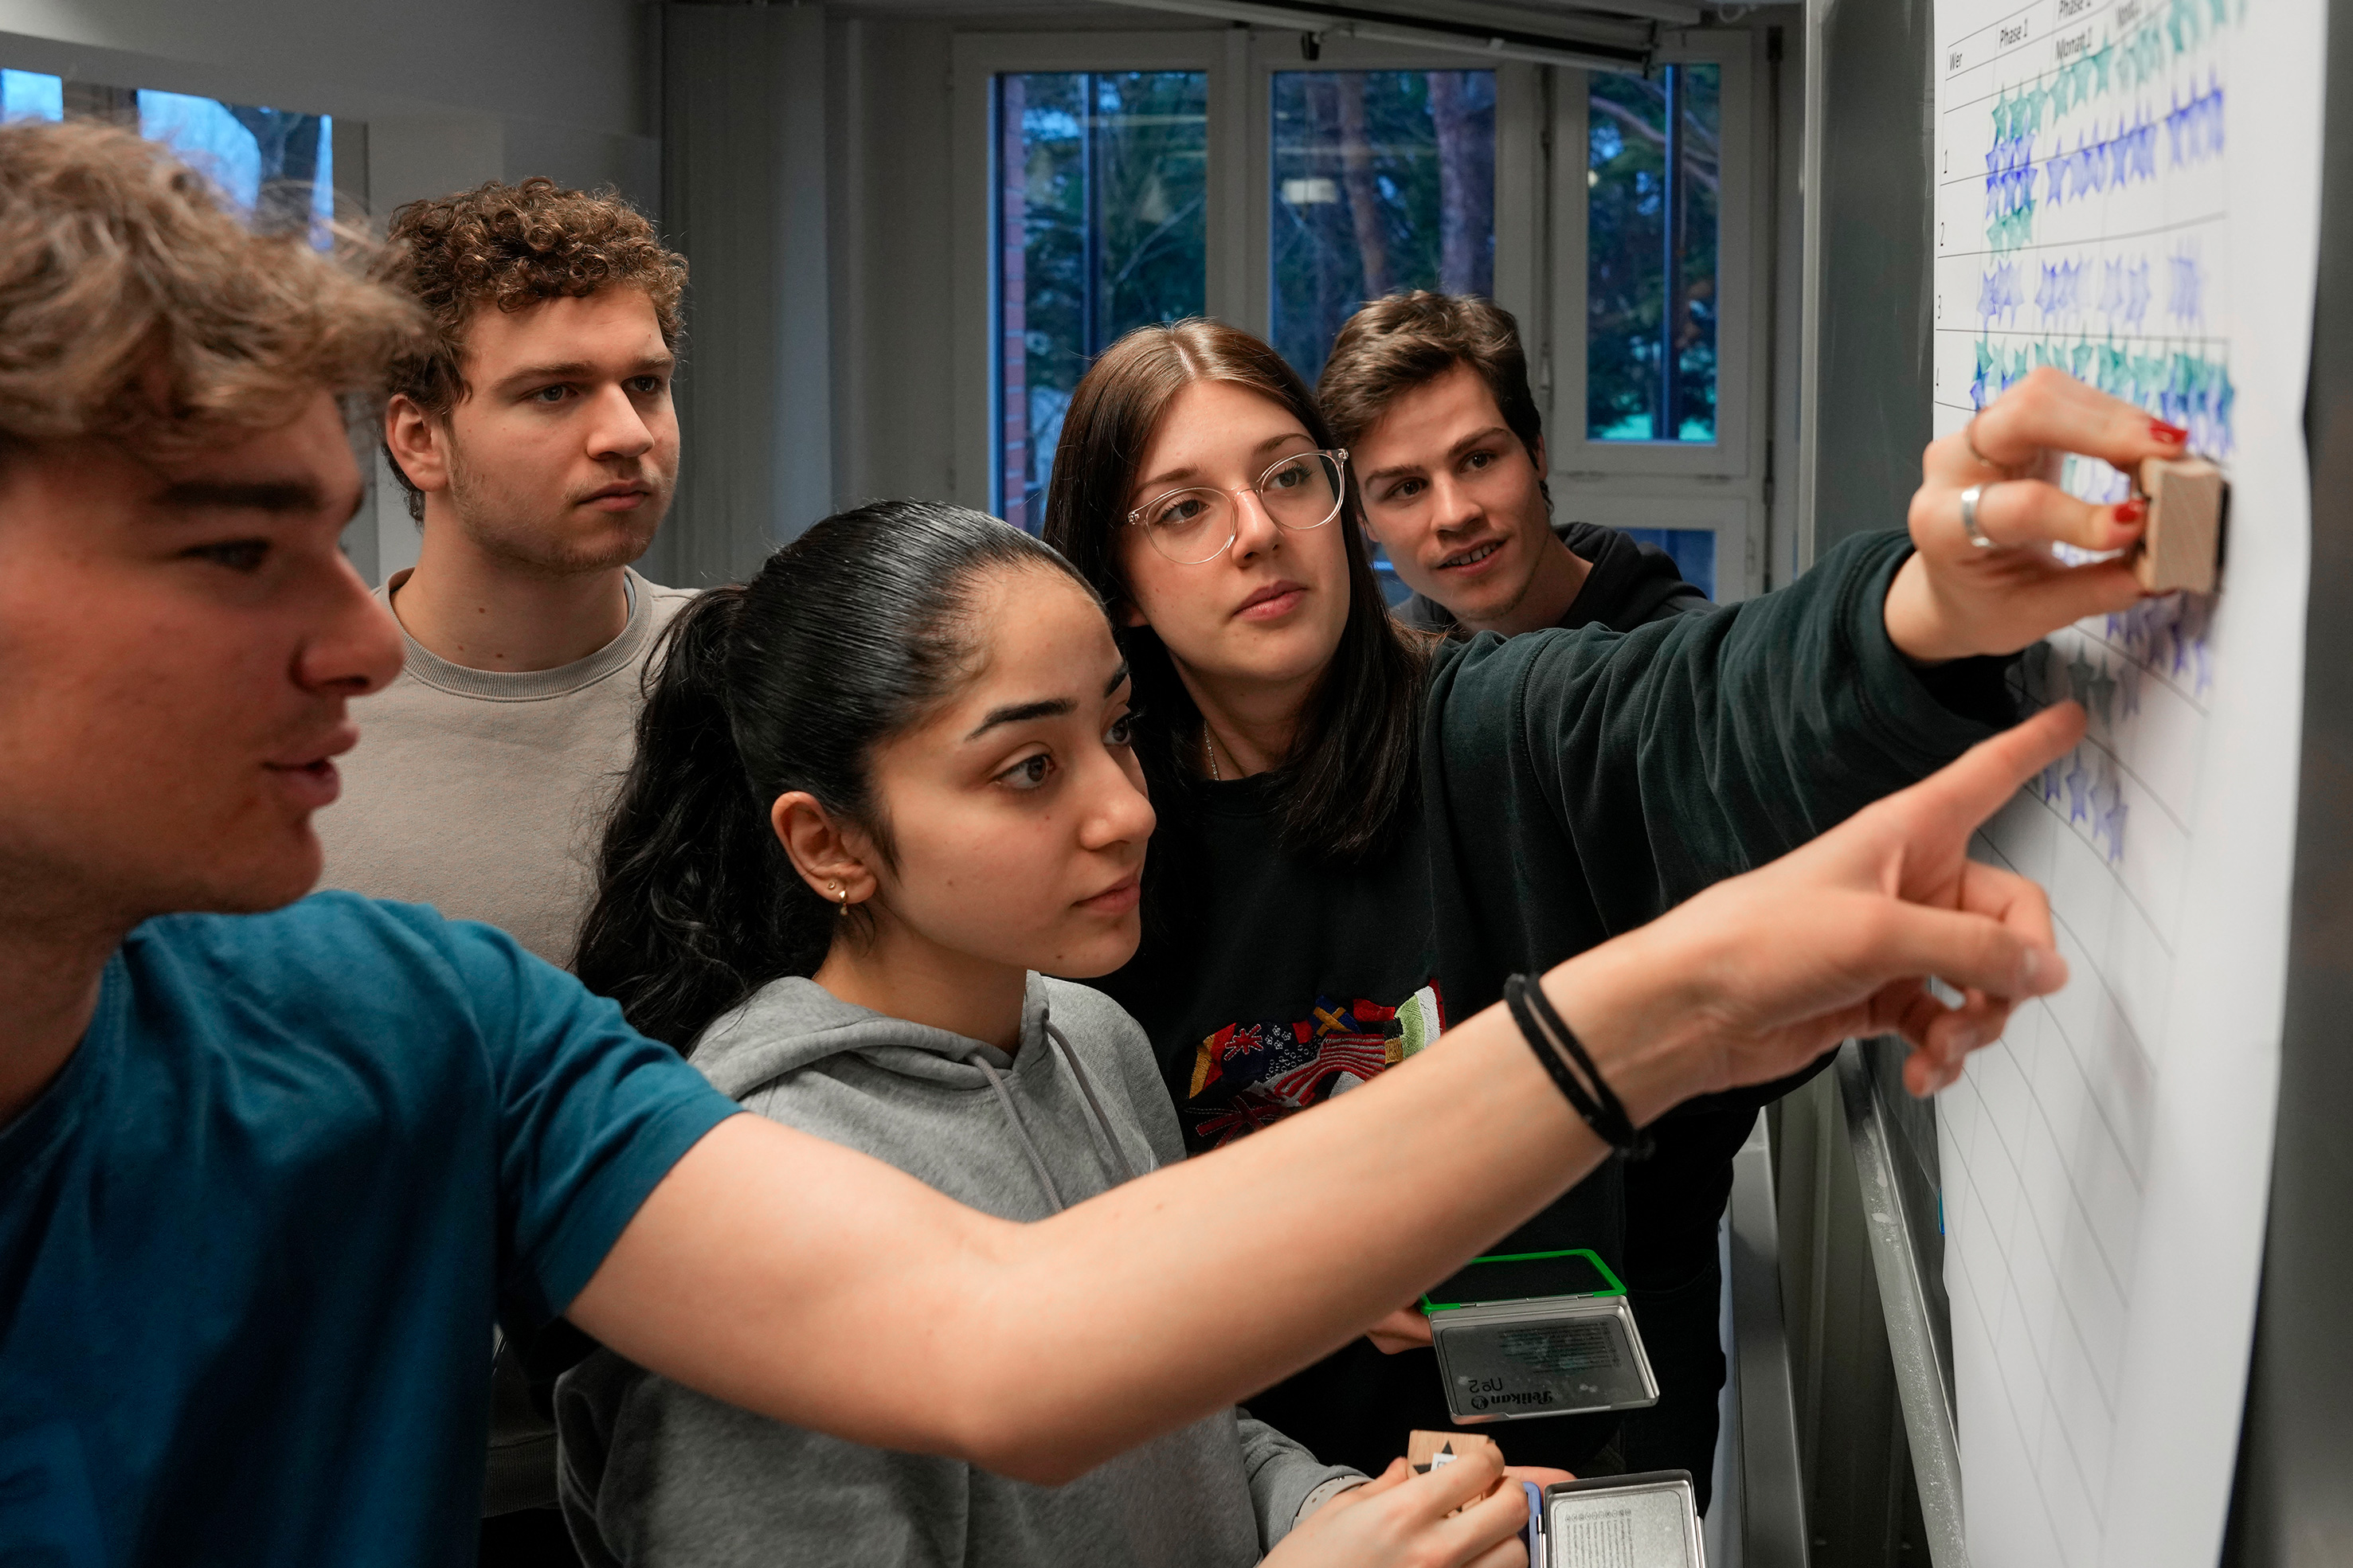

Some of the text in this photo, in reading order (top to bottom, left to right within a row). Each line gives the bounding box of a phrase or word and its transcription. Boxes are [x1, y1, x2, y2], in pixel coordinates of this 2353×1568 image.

[1999, 17, 2028, 49] Phase 1
[1949, 52, 1963, 71] Wer
[1490, 1391, 1552, 1405] Pelikan
